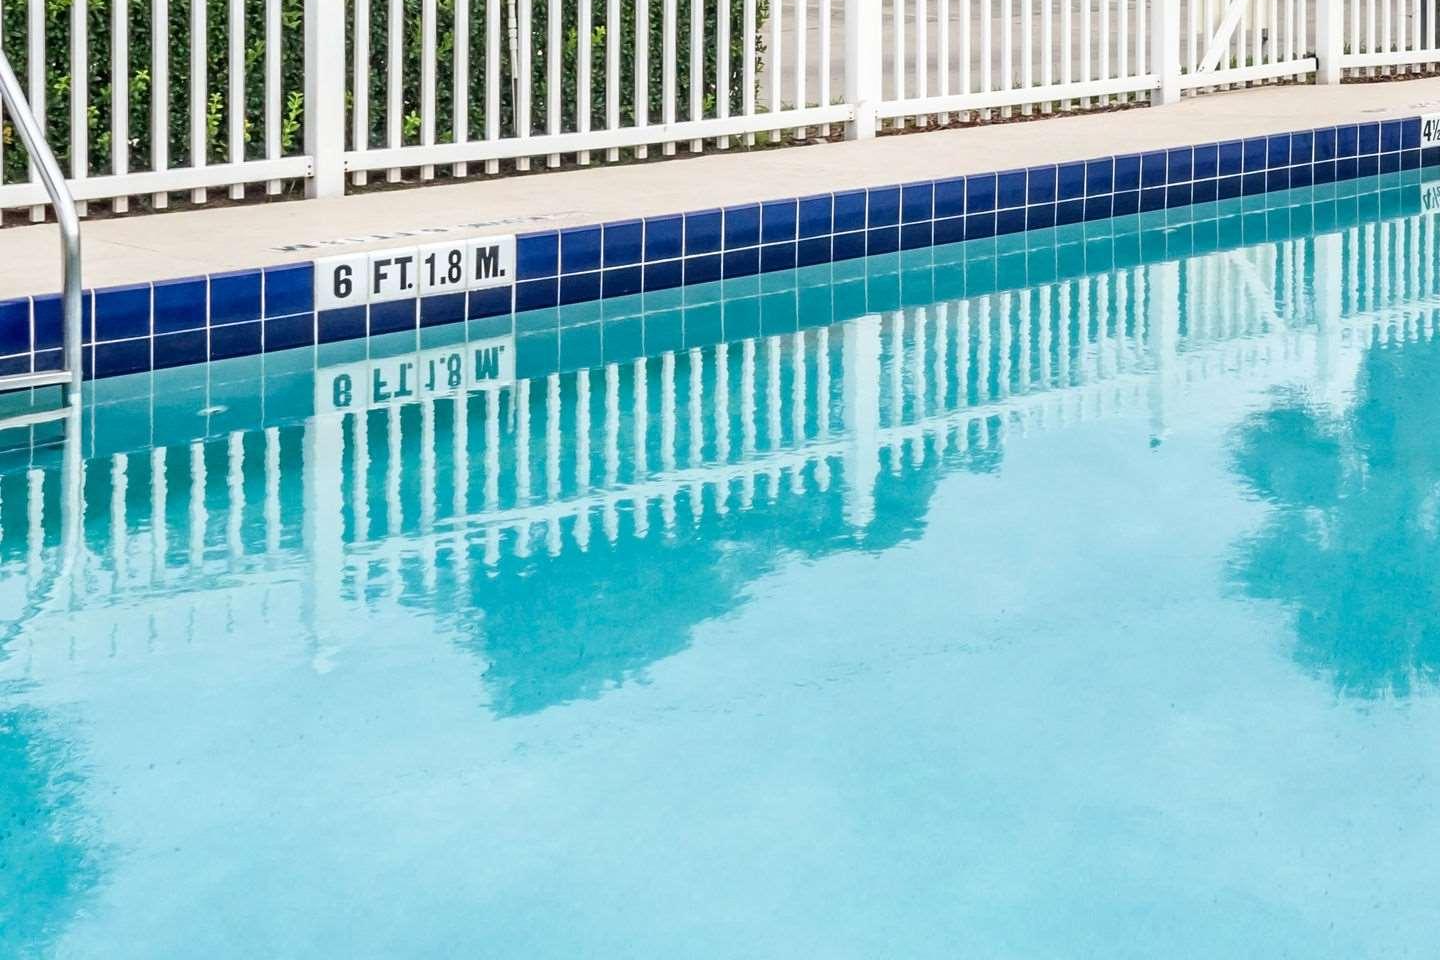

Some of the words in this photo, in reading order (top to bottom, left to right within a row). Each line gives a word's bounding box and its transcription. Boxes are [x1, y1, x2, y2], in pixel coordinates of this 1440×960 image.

[333, 264, 352, 298] 6
[373, 256, 413, 294] FT.
[425, 249, 462, 286] 1.8
[475, 245, 505, 280] M.
